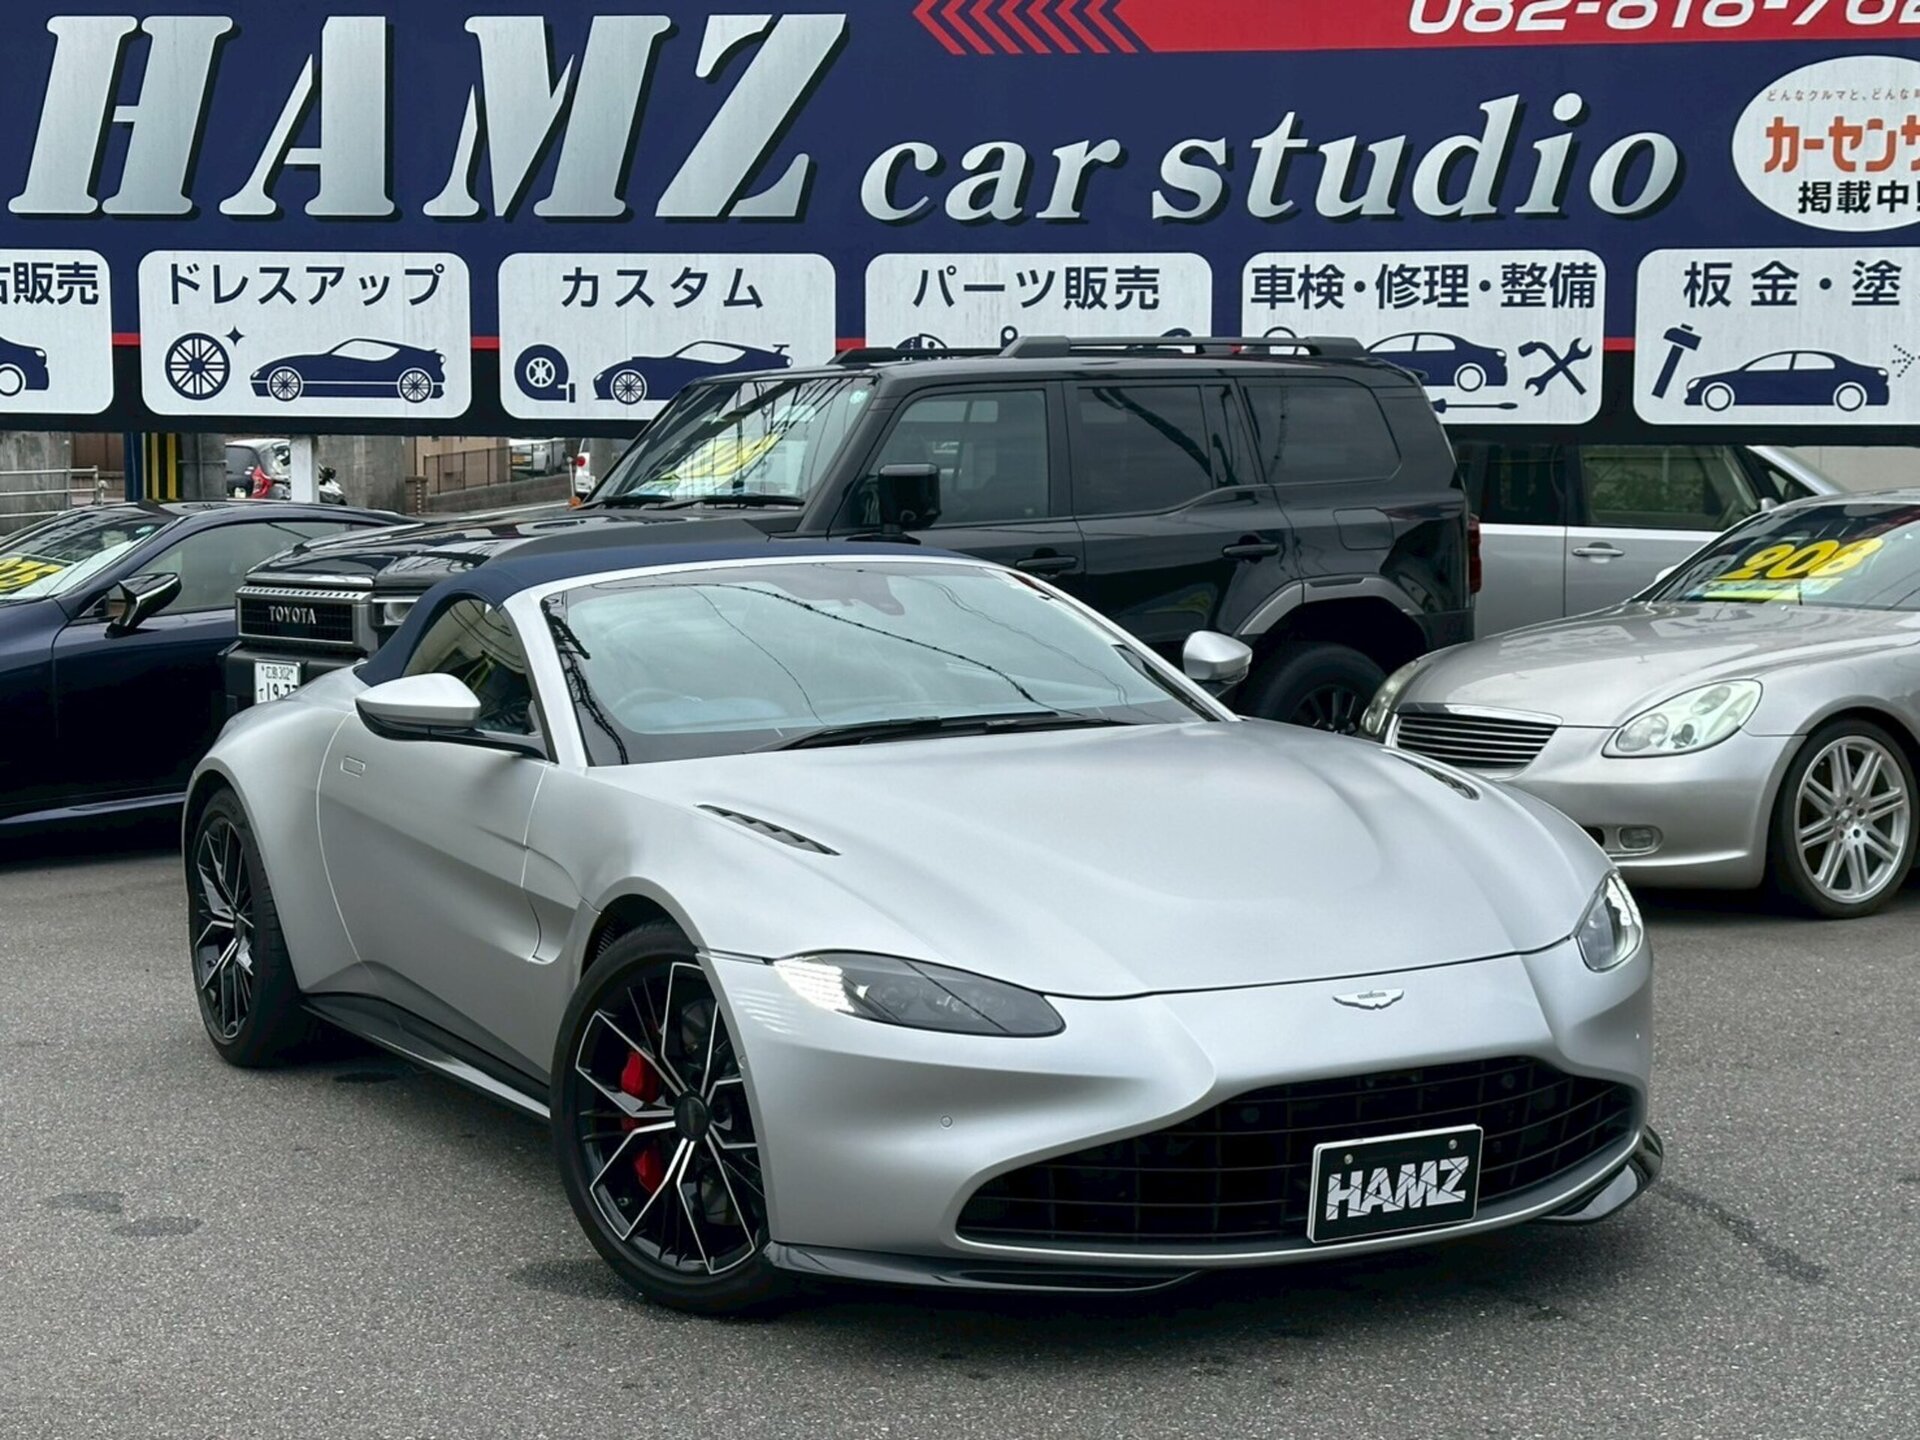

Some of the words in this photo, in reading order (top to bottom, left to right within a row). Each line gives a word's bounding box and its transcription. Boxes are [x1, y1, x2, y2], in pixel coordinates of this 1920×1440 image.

[1767, 88, 1920, 102] どんなクルマと、どんな
[8, 14, 847, 218] HAMZ
[860, 138, 1121, 222] car
[1151, 92, 1679, 221] studio
[0, 261, 99, 305] 販売
[169, 262, 445, 306] ドレスアップ
[561, 266, 764, 309] カスタム
[912, 265, 1160, 310] パーツ販売
[1250, 261, 1597, 310] 車検・修理・整備
[269, 606, 316, 624] TOYOTA
[1325, 1155, 1470, 1222] HAMZ
